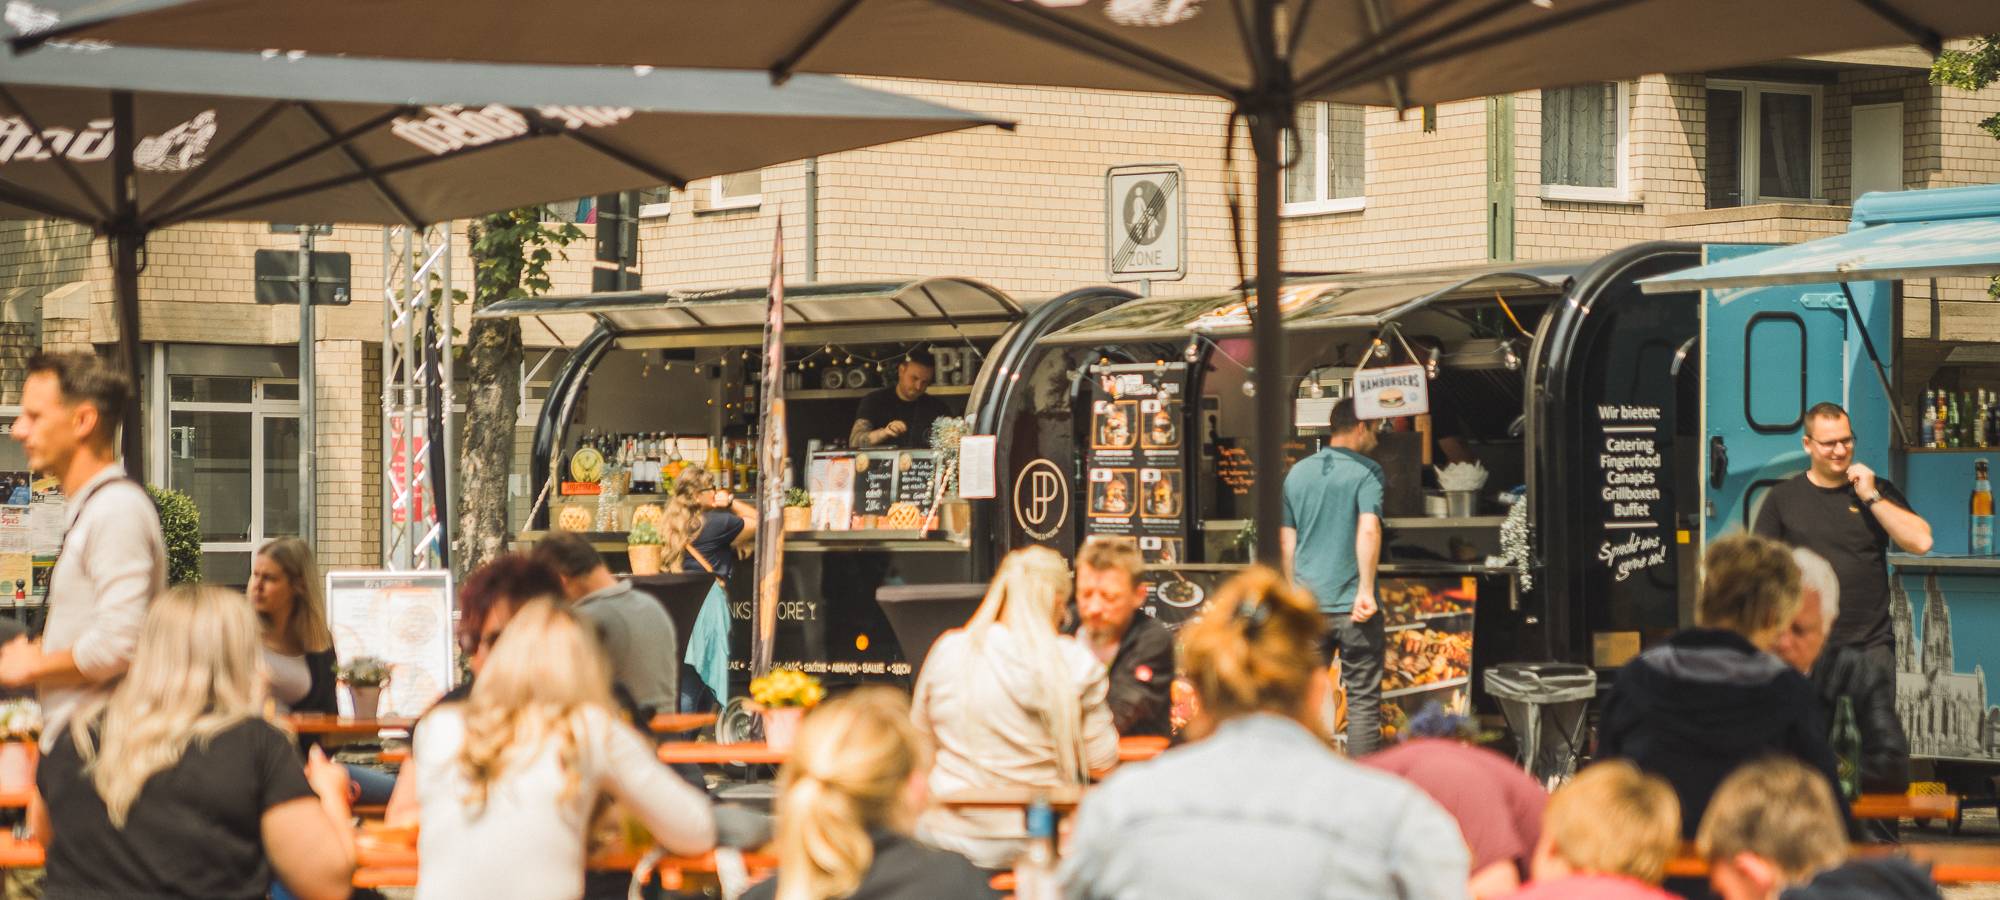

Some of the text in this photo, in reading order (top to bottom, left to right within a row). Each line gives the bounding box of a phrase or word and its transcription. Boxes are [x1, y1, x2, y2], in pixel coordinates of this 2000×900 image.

[1127, 249, 1163, 267] ZONE
[1360, 373, 1420, 393] HAMBURGERS
[1598, 405, 1661, 420] Wir bieten:
[1606, 438, 1655, 455] Catering
[1600, 453, 1661, 472] Fingerfood
[1607, 469, 1656, 487] Canapés
[1602, 486, 1660, 501] Grillboxen
[1614, 503, 1651, 518] Buffet
[728, 601, 805, 620] NKS ORE
